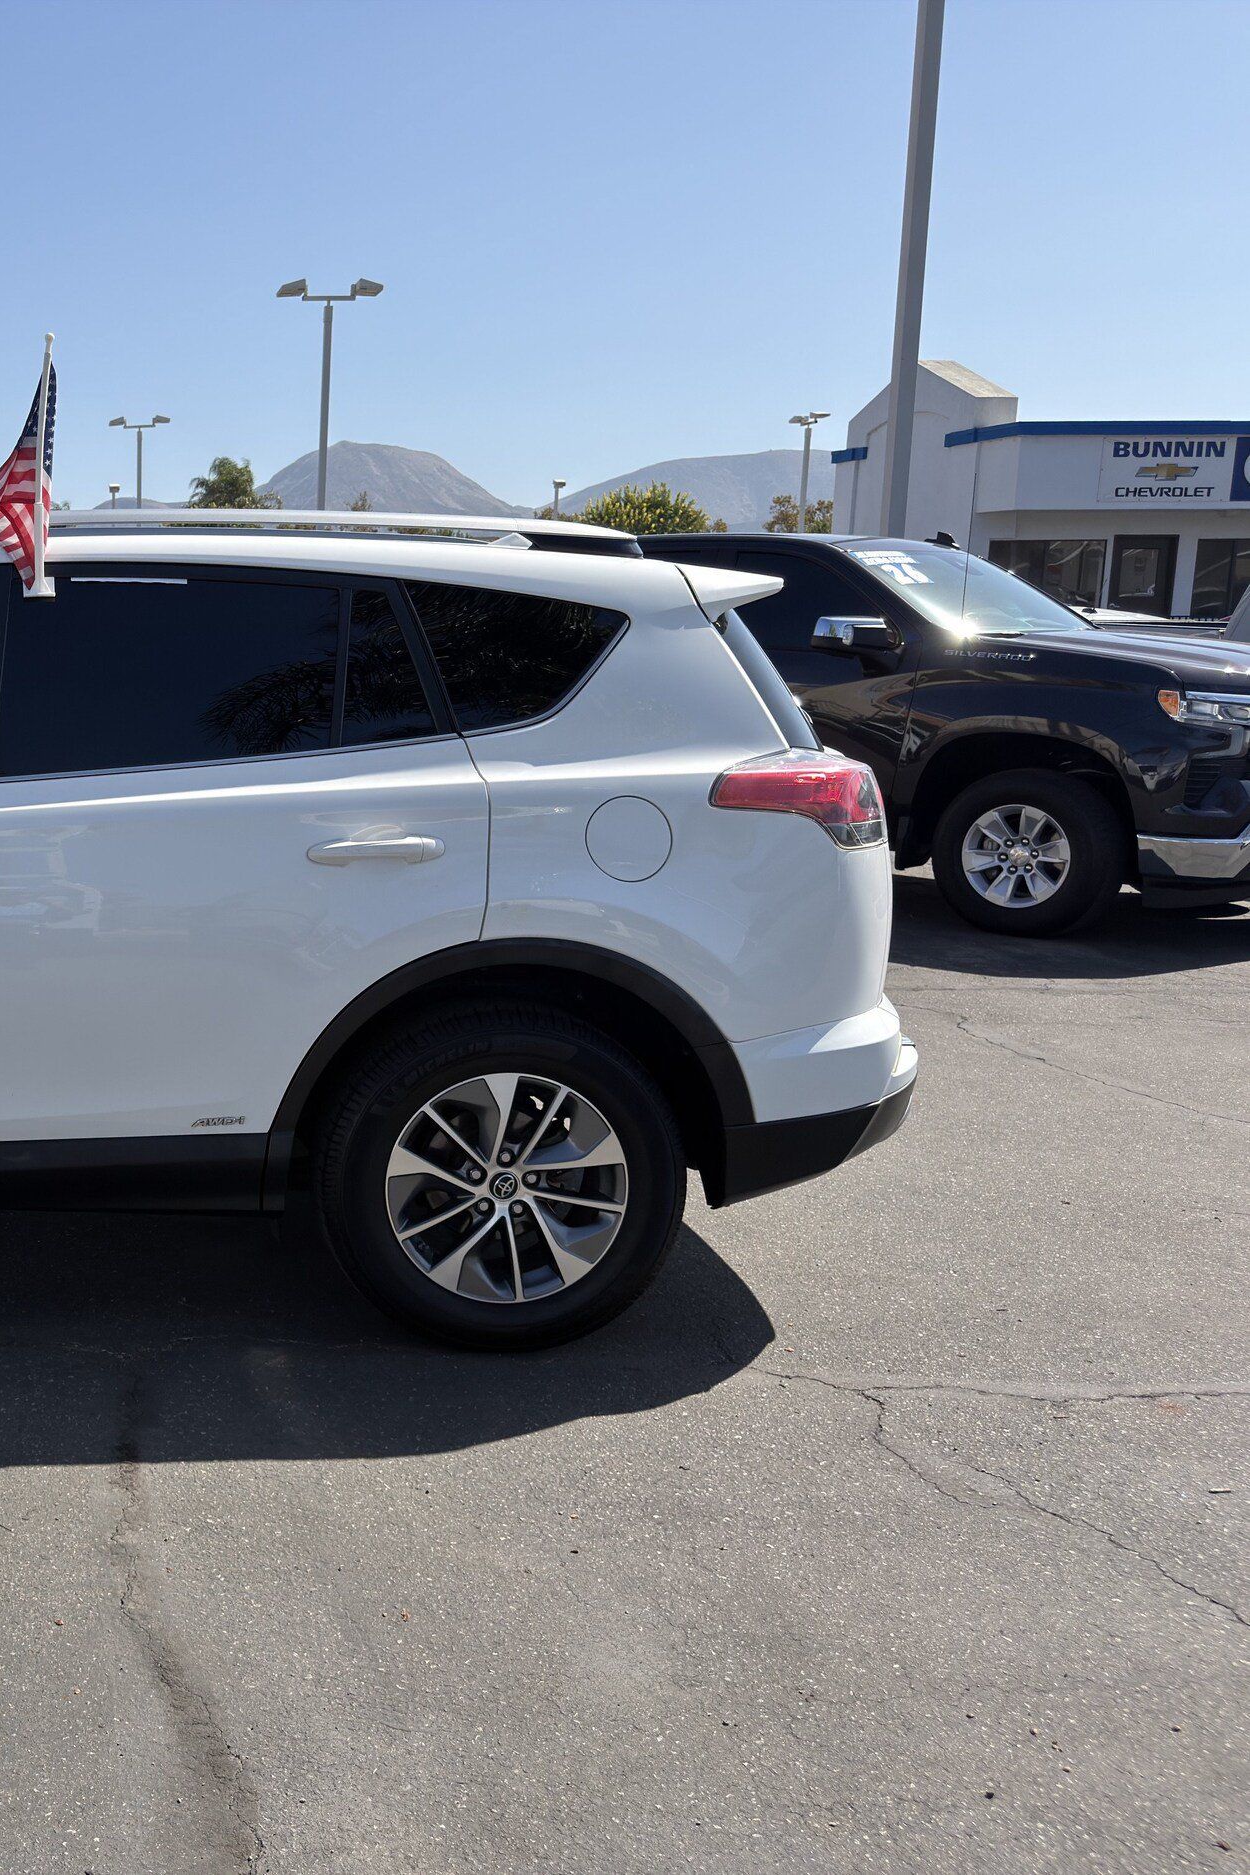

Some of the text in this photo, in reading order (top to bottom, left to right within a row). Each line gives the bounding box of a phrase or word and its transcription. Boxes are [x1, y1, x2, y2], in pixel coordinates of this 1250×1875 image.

[1112, 441, 1227, 458] BUNNIN
[1114, 486, 1215, 498] CHEVROLET
[944, 649, 1035, 662] SILVERADO
